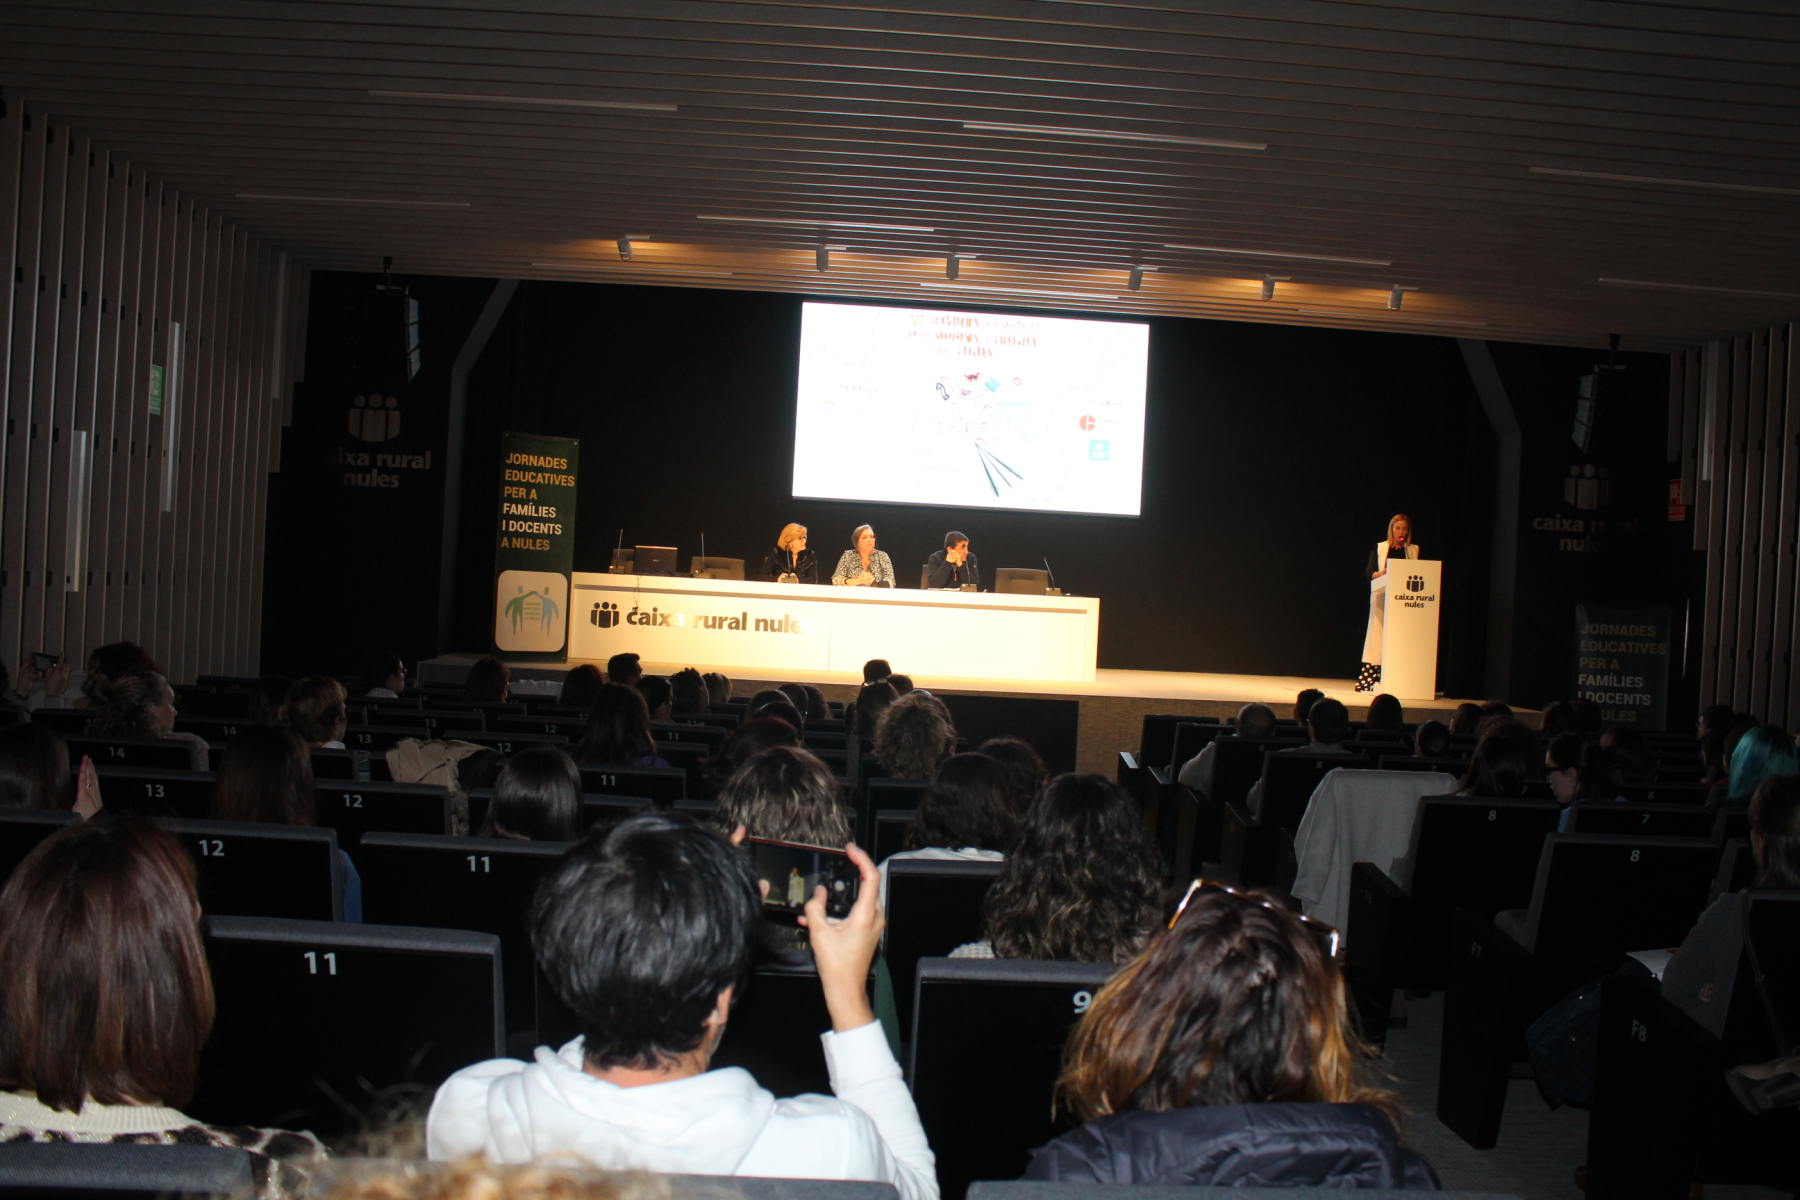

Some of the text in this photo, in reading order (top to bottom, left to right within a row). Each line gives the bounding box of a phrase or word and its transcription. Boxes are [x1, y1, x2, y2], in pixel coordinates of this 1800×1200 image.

[376, 449, 432, 470] rural
[505, 453, 568, 470] JORNADES
[342, 468, 400, 489] nules
[504, 469, 575, 487] EDUCATIVES
[503, 486, 538, 500] PER A
[502, 502, 557, 518] FAMÍLIES
[502, 519, 562, 535] I DOCENTS
[1532, 513, 1585, 533] caixa
[500, 536, 550, 551] A NULES
[1559, 535, 1601, 552] nule
[1394, 593, 1435, 602] caixa rural
[1404, 600, 1425, 608] nules
[626, 607, 685, 628] caixa
[692, 611, 748, 631] rural
[1581, 623, 1657, 637] JORNADES
[1580, 640, 1667, 655] EDUCATIVES
[1579, 656, 1620, 670] PER A
[1578, 672, 1644, 688] FAMÍLIES
[1585, 691, 1652, 706] DOCENTS
[425, 718, 437, 728] 13
[1601, 709, 1637, 722] ULES
[222, 726, 237, 736] 14
[544, 725, 557, 734] 12
[667, 731, 679, 741] 11
[358, 733, 372, 744] 13
[109, 746, 125, 758] 14
[498, 742, 512, 753] 12
[600, 774, 616, 787] 11
[145, 783, 165, 798] 13
[1520, 785, 1528, 795] 7
[1648, 791, 1655, 800] 6
[343, 793, 363, 808] 12
[1488, 810, 1497, 821] 8
[1641, 814, 1650, 824] 7
[199, 839, 225, 857] 12
[1630, 849, 1641, 862] 8
[466, 855, 490, 873] 11
[1471, 941, 1482, 959] F7
[303, 951, 337, 976] 11
[1072, 990, 1093, 1014] 9
[1631, 1018, 1647, 1042] F8
